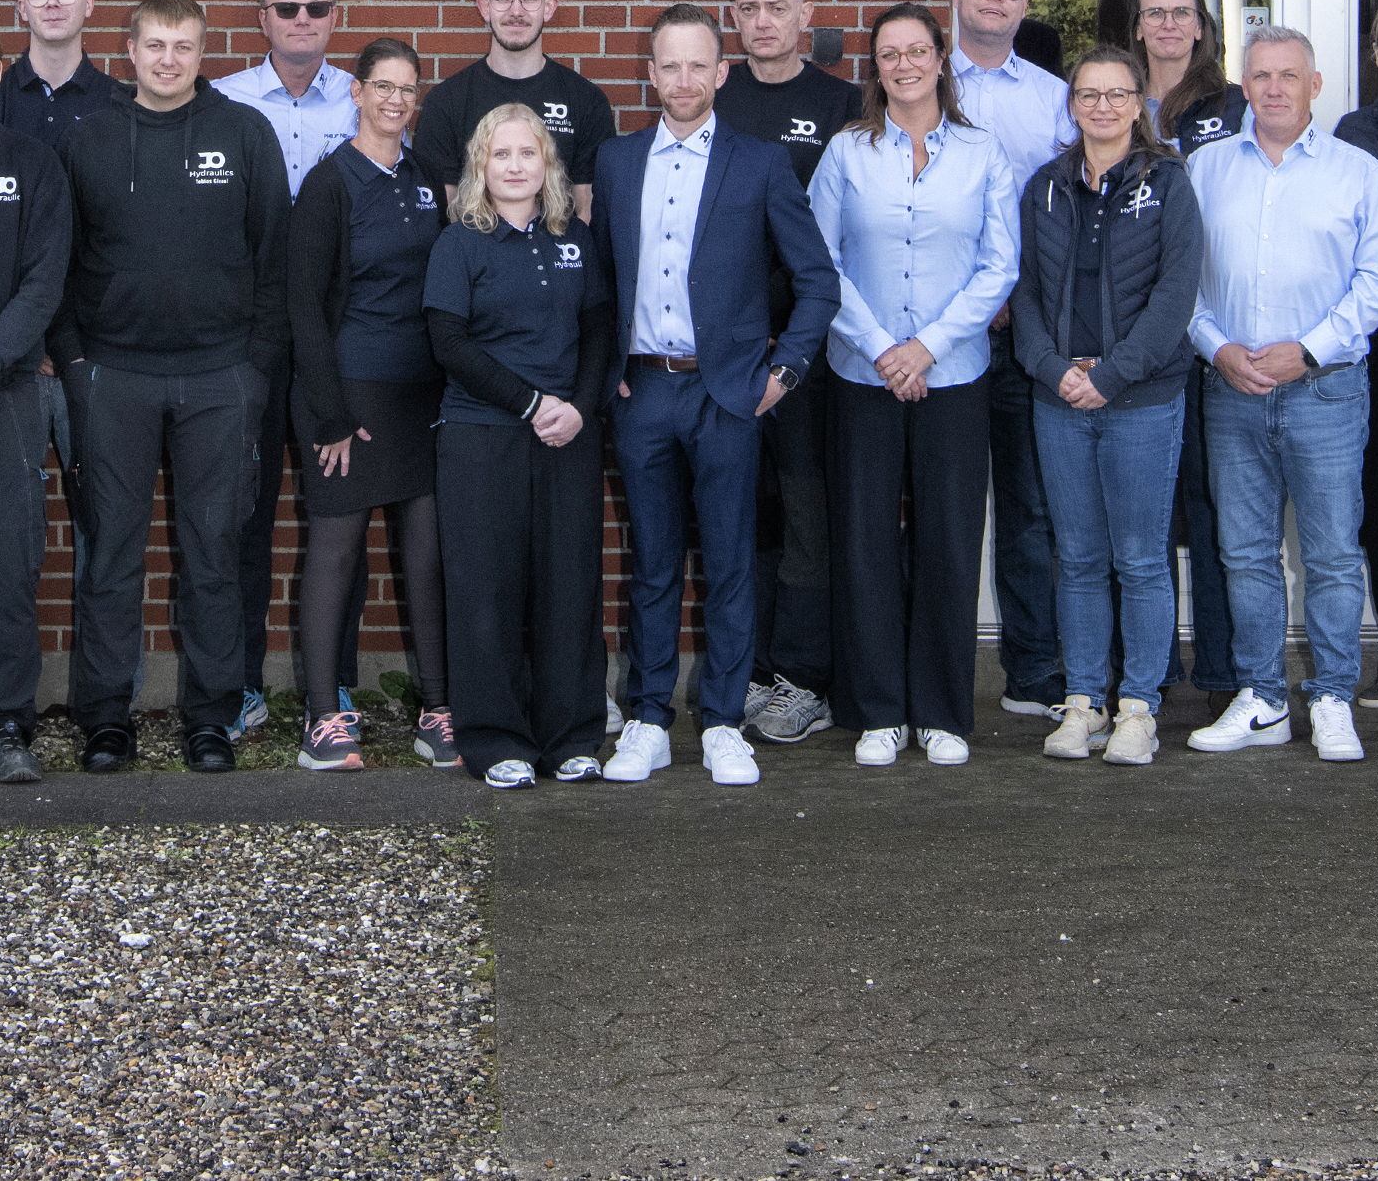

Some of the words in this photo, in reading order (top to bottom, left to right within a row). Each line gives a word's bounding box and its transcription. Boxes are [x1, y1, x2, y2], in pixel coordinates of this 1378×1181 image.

[543, 102, 568, 120] JO
[790, 118, 817, 136] JO
[780, 134, 823, 146] Hydraulics
[197, 151, 226, 169] JO
[189, 170, 234, 178] Hydraulics
